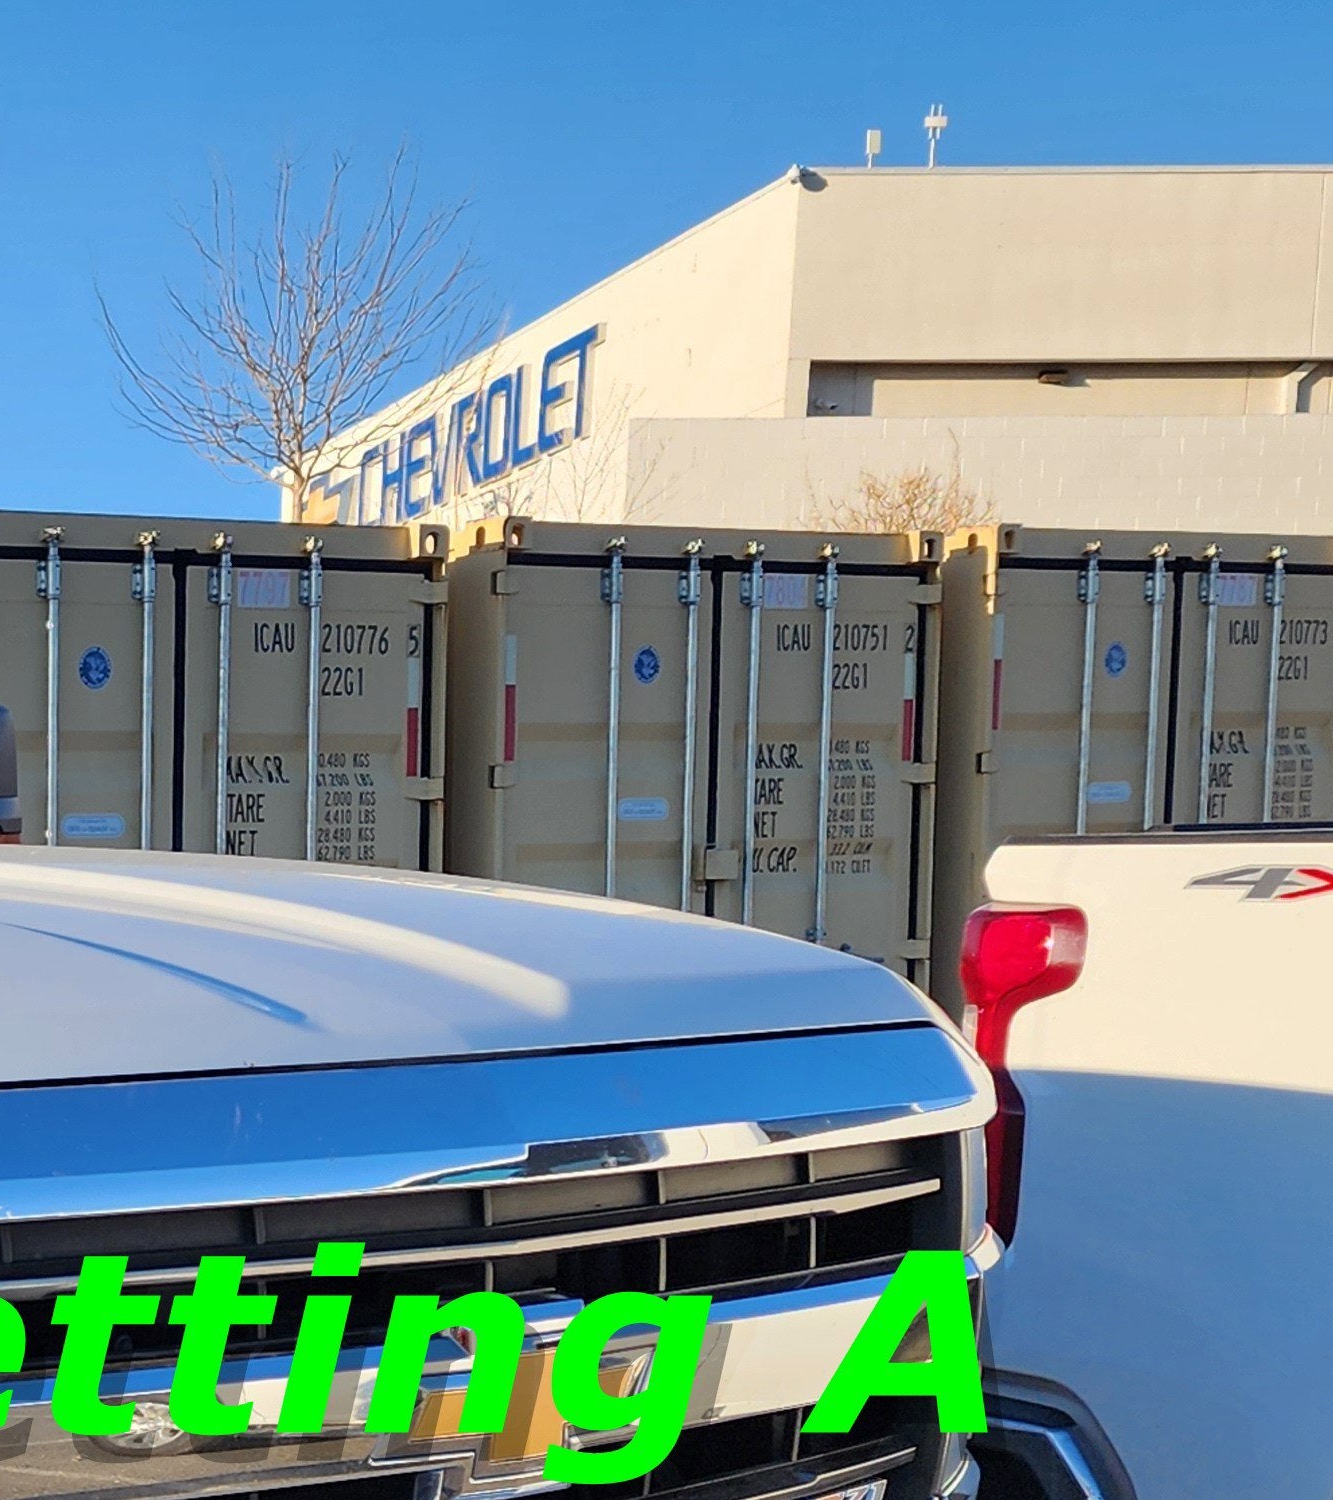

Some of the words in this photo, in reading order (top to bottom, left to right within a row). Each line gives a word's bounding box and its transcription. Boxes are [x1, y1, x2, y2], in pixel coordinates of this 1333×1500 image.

[359, 324, 606, 524] CHEVROLET
[254, 622, 295, 653] ICAU
[322, 624, 389, 655] 210776
[408, 625, 420, 656] 5
[777, 623, 811, 651] ICAU
[833, 624, 888, 651] 210751
[904, 625, 916, 651] 2
[1229, 620, 1259, 645] ICAU
[1279, 620, 1328, 645] 210773
[321, 667, 363, 696] 22G1
[833, 663, 868, 690] 22G1
[1277, 656, 1308, 680] 22G1
[226, 793, 265, 823] TARE
[359, 791, 376, 806] KGS
[358, 809, 376, 824] LBS
[225, 830, 258, 857] NET
[358, 828, 375, 843] KGS
[357, 845, 375, 860] LBS
